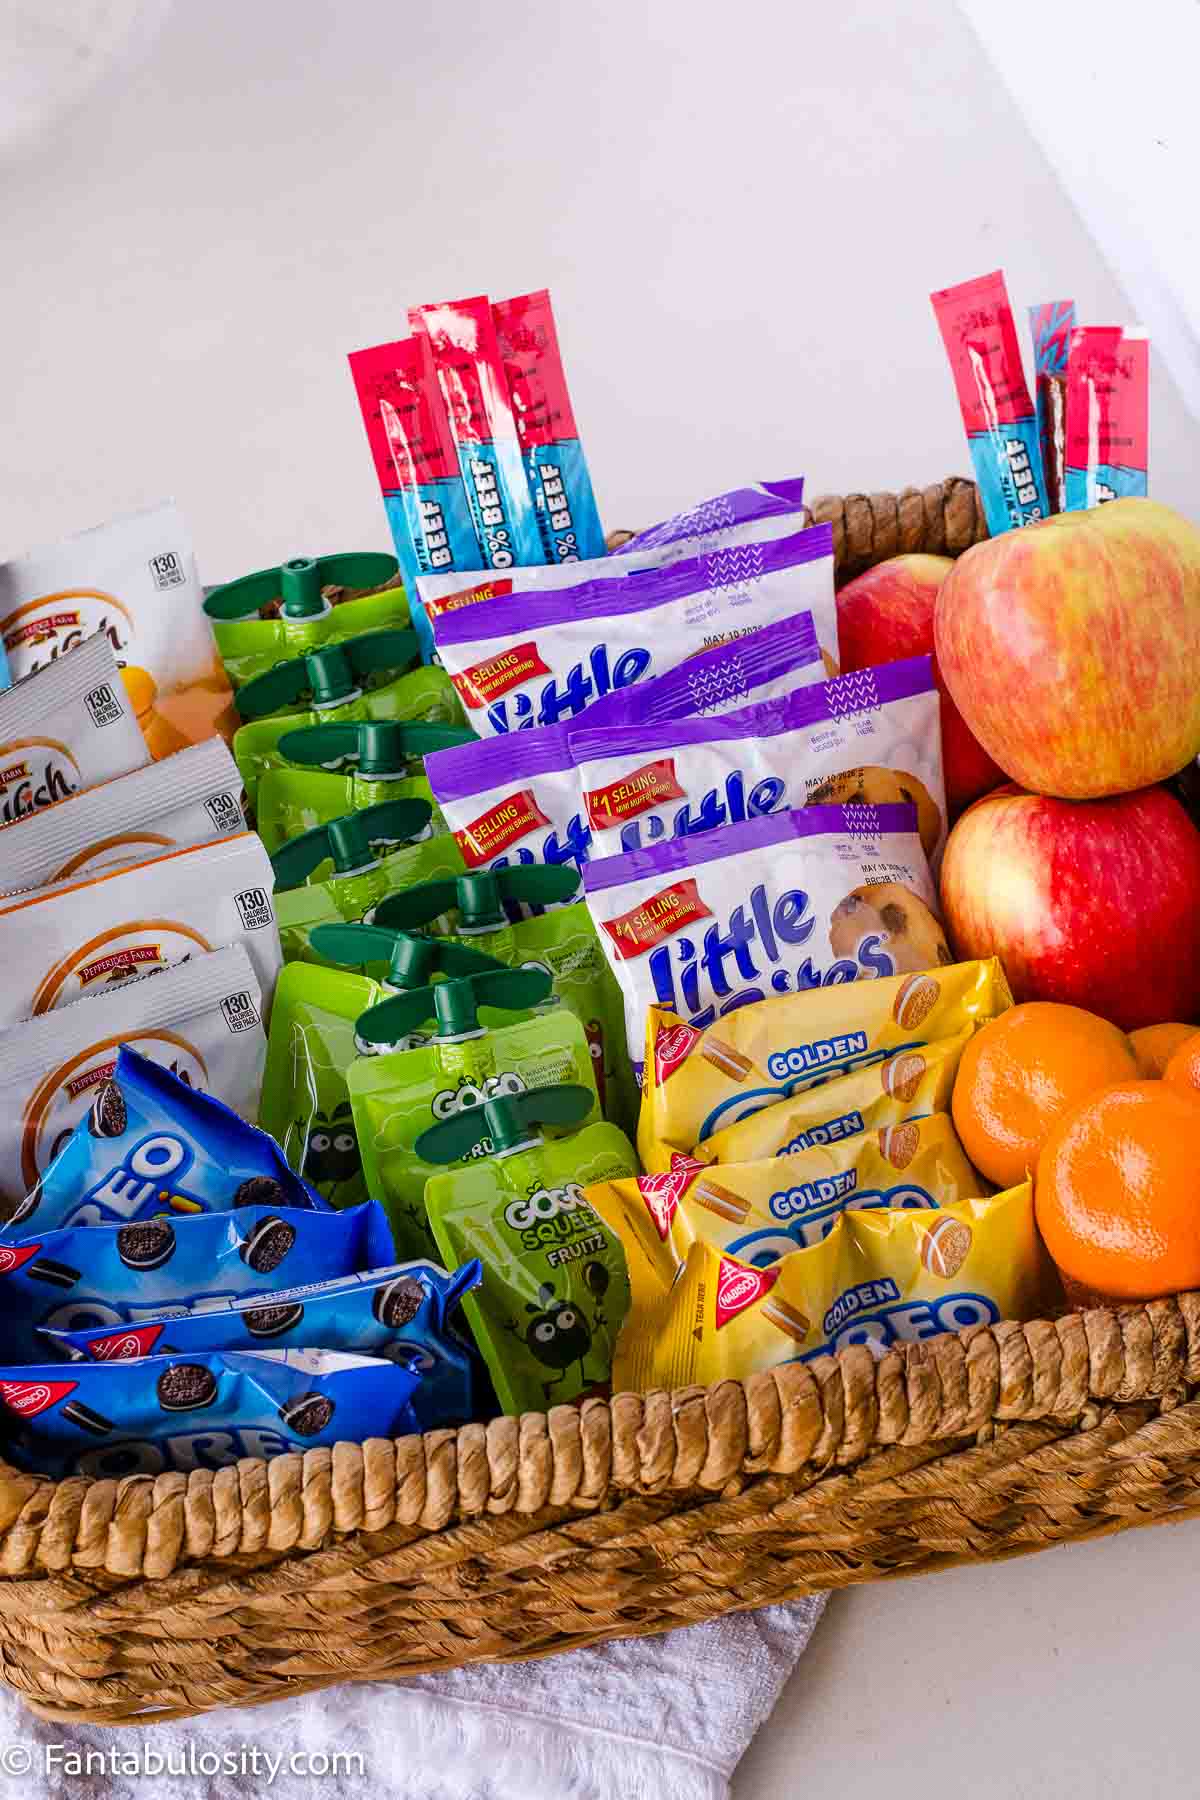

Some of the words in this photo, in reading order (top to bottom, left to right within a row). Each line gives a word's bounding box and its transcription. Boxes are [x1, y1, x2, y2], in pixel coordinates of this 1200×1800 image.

[1007, 440, 1038, 504] BEEF
[471, 460, 504, 525] BEEF
[541, 465, 571, 530] BEEF
[422, 501, 452, 567] BEEF
[152, 553, 176, 574] 130
[703, 634, 725, 646] MAY
[472, 655, 519, 685] SELLING
[493, 669, 515, 690] MUFFIN
[514, 659, 536, 676] BRAND
[87, 686, 111, 709] 130
[93, 701, 117, 718] CALORIES
[106, 708, 121, 720] PACK
[1, 768, 23, 783] FARM
[805, 777, 824, 789] MAY
[208, 795, 233, 815] 130
[593, 793, 612, 816] #1
[612, 771, 657, 803] SELLING
[473, 805, 518, 842] SELLING
[494, 825, 515, 846] MUFFIN
[861, 864, 877, 873] MAY
[238, 890, 264, 911] 130
[243, 906, 269, 920] CALORIES
[246, 918, 257, 928] PER
[257, 914, 271, 925] PACK
[616, 921, 639, 944] #1
[634, 894, 679, 929] SELLING
[655, 914, 676, 931] MUFFIN
[676, 903, 696, 920] BRAND
[649, 884, 816, 1013] little
[83, 954, 129, 980] PEPPERIDGE
[130, 950, 154, 961] FARM
[224, 994, 249, 1014] 130
[229, 1009, 254, 1024] CALORIES
[232, 1021, 243, 1031] PER
[242, 1016, 257, 1028] PACK
[771, 1036, 865, 1077] GOLDEN
[773, 1173, 856, 1216] GOLDEN
[547, 1233, 607, 1267] FRUITZ
[720, 1277, 756, 1306] NABISCO
[824, 1282, 896, 1332] GOLDEN
